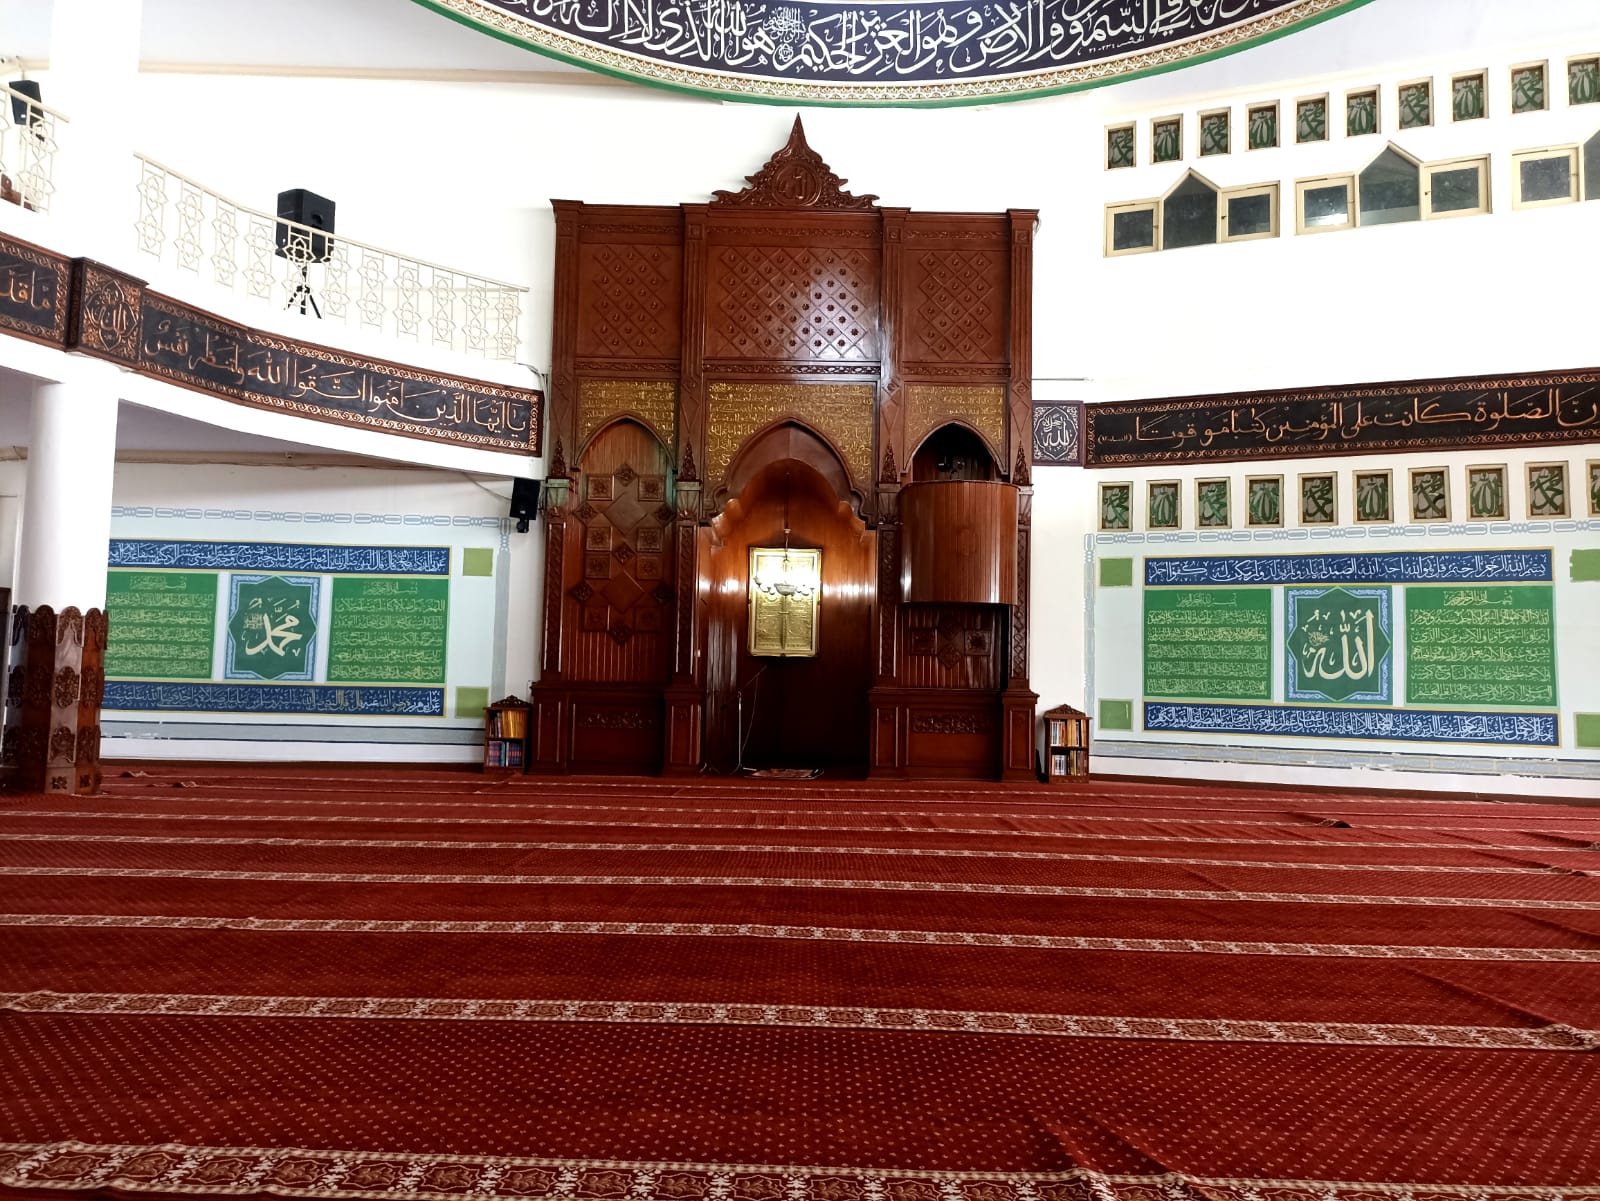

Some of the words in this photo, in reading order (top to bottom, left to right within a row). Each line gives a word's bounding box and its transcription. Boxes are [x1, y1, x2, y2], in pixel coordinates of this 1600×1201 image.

[1043, 421, 1070, 447] الله
[245, 613, 303, 656] محمد
[1302, 609, 1374, 680] الله
